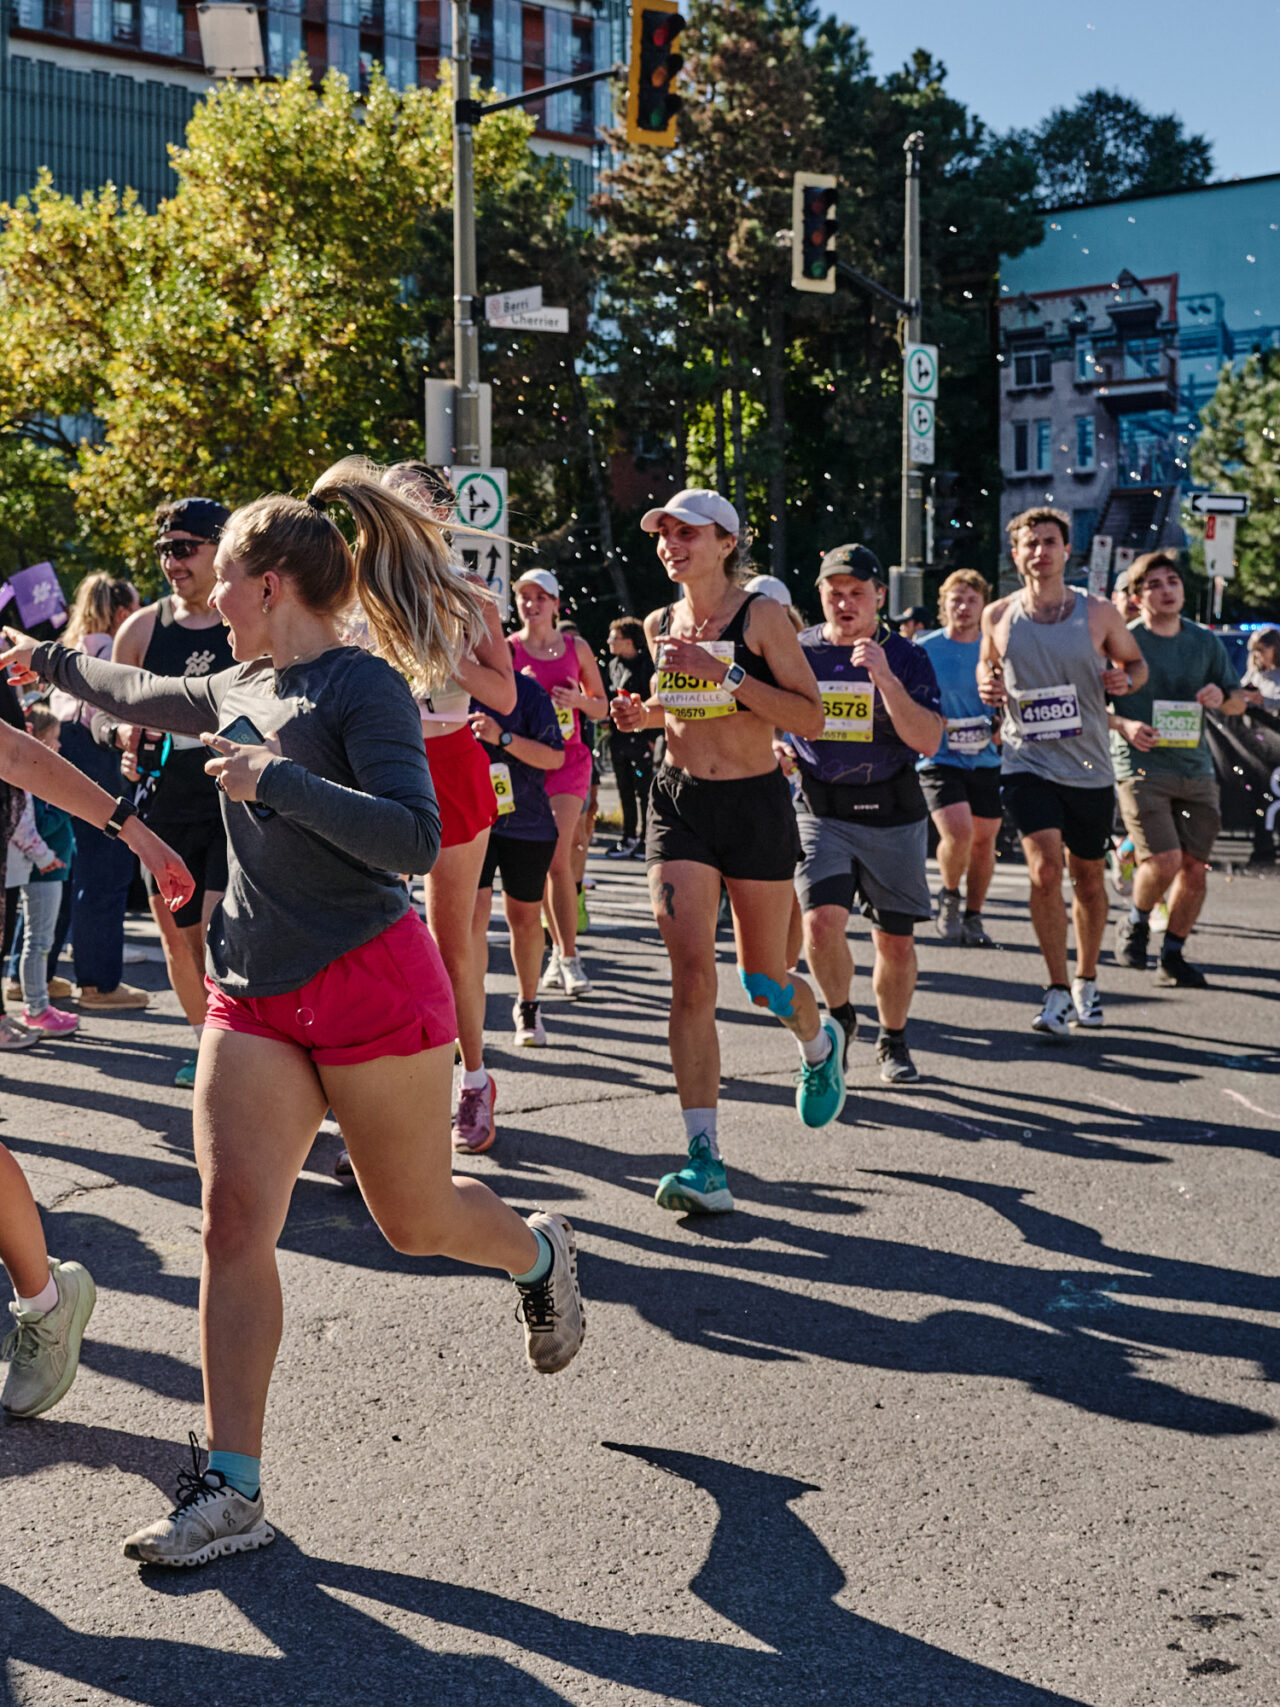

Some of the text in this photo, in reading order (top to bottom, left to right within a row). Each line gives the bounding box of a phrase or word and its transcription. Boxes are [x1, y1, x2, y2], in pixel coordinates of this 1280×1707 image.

[504, 298, 529, 313] Berri
[511, 314, 559, 327] Cherrier
[1023, 702, 1075, 721] 41680
